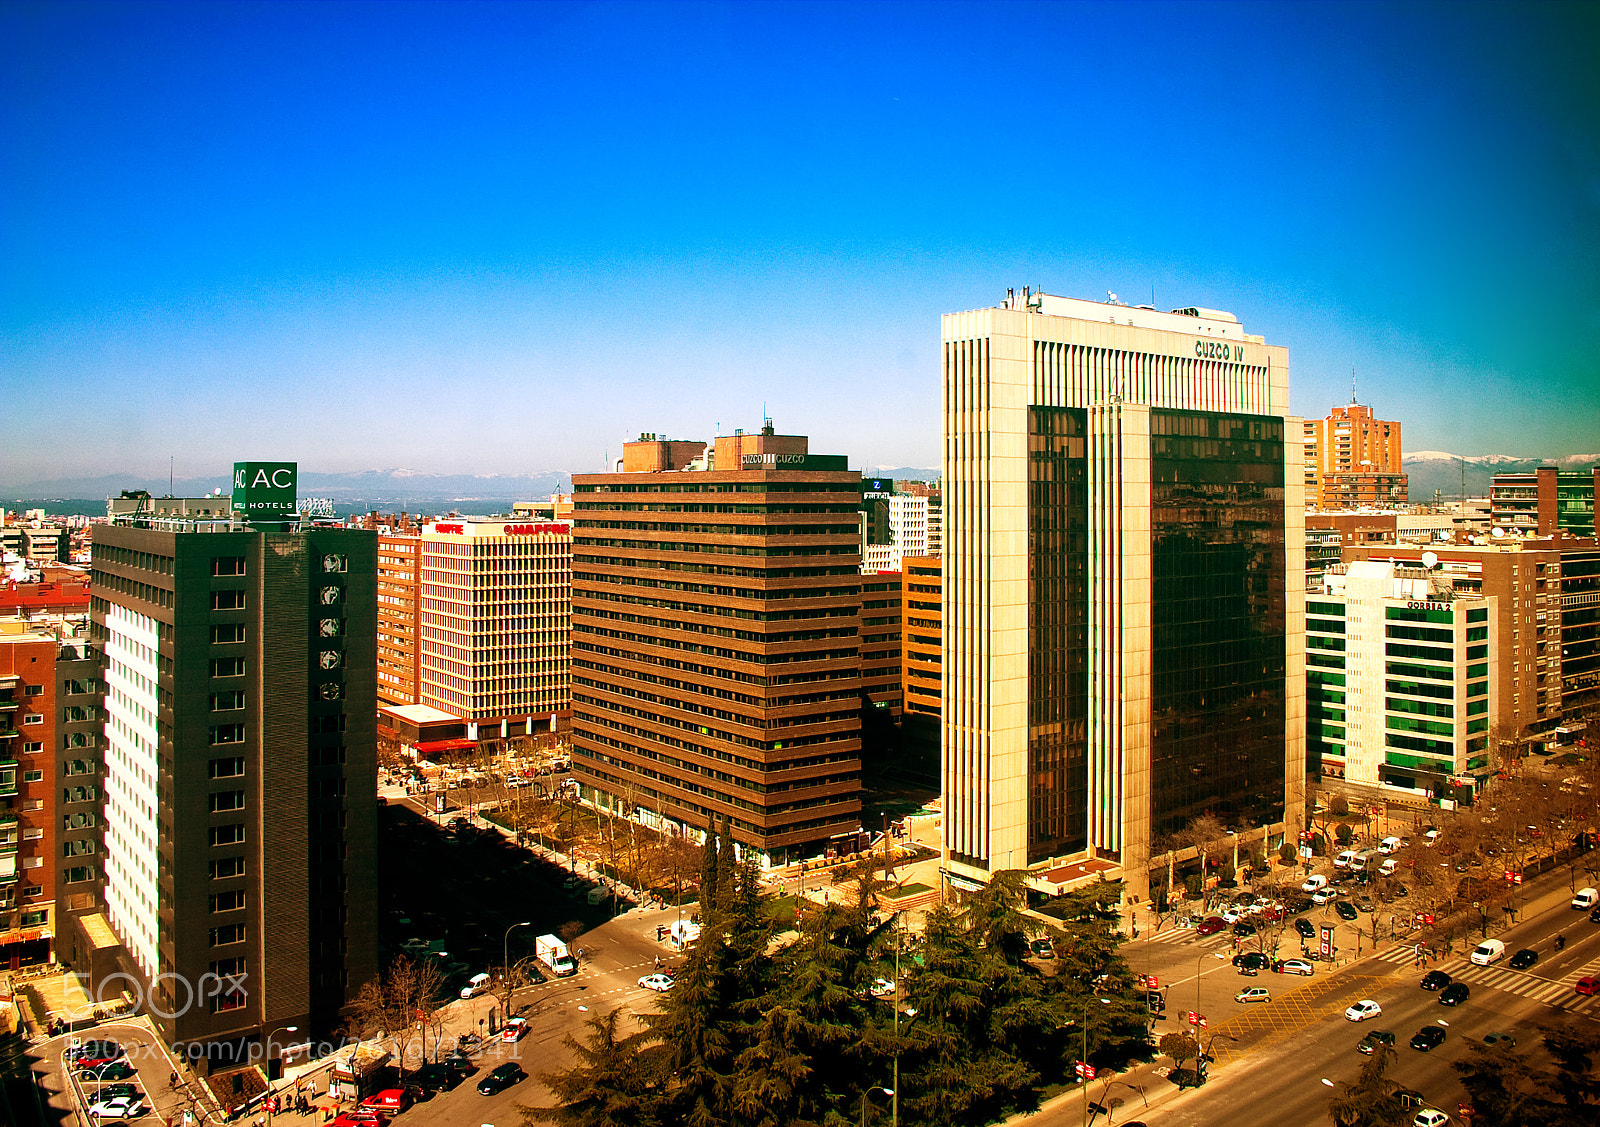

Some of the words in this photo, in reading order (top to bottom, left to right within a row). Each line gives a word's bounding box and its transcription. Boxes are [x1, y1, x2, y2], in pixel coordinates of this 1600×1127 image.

[1195, 340, 1230, 361] CUZCO
[1234, 345, 1244, 362] IV
[742, 454, 762, 464] CUZCO
[776, 454, 805, 464] CUZCO
[234, 468, 246, 489] AC
[251, 468, 292, 489] AC
[512, 523, 571, 535] MAPFRE
[1445, 603, 1451, 612] 2
